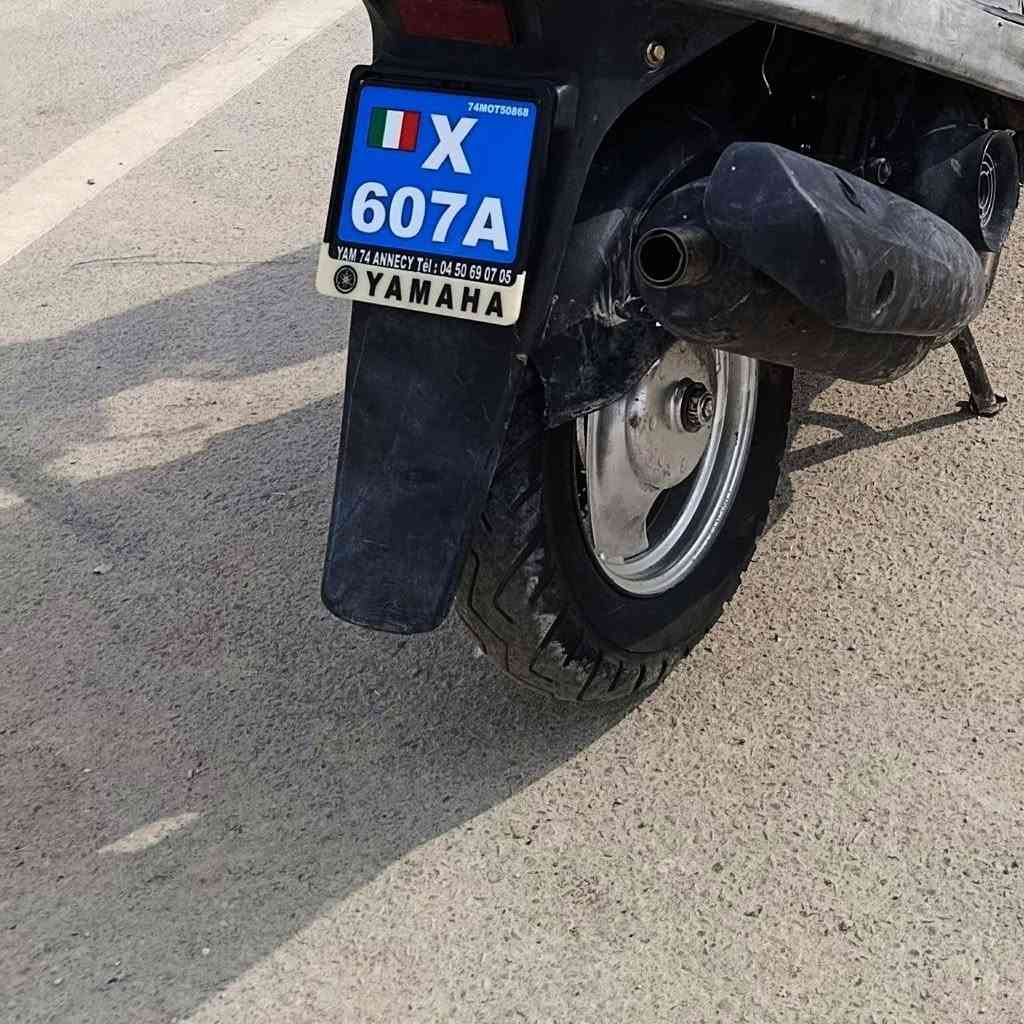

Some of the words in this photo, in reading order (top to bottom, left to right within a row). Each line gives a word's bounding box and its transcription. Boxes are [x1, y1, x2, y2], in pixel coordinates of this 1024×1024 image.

[421, 114, 478, 174] X
[352, 181, 509, 251] 607A
[337, 246, 357, 263] YAM
[359, 249, 371, 264] 74
[373, 251, 414, 270] ANNECY
[440, 260, 452, 276] 04
[454, 262, 467, 278] 50
[469, 264, 482, 280] 69
[484, 266, 498, 282] 07
[499, 268, 512, 284] 05
[366, 270, 504, 318] YAMAHA
